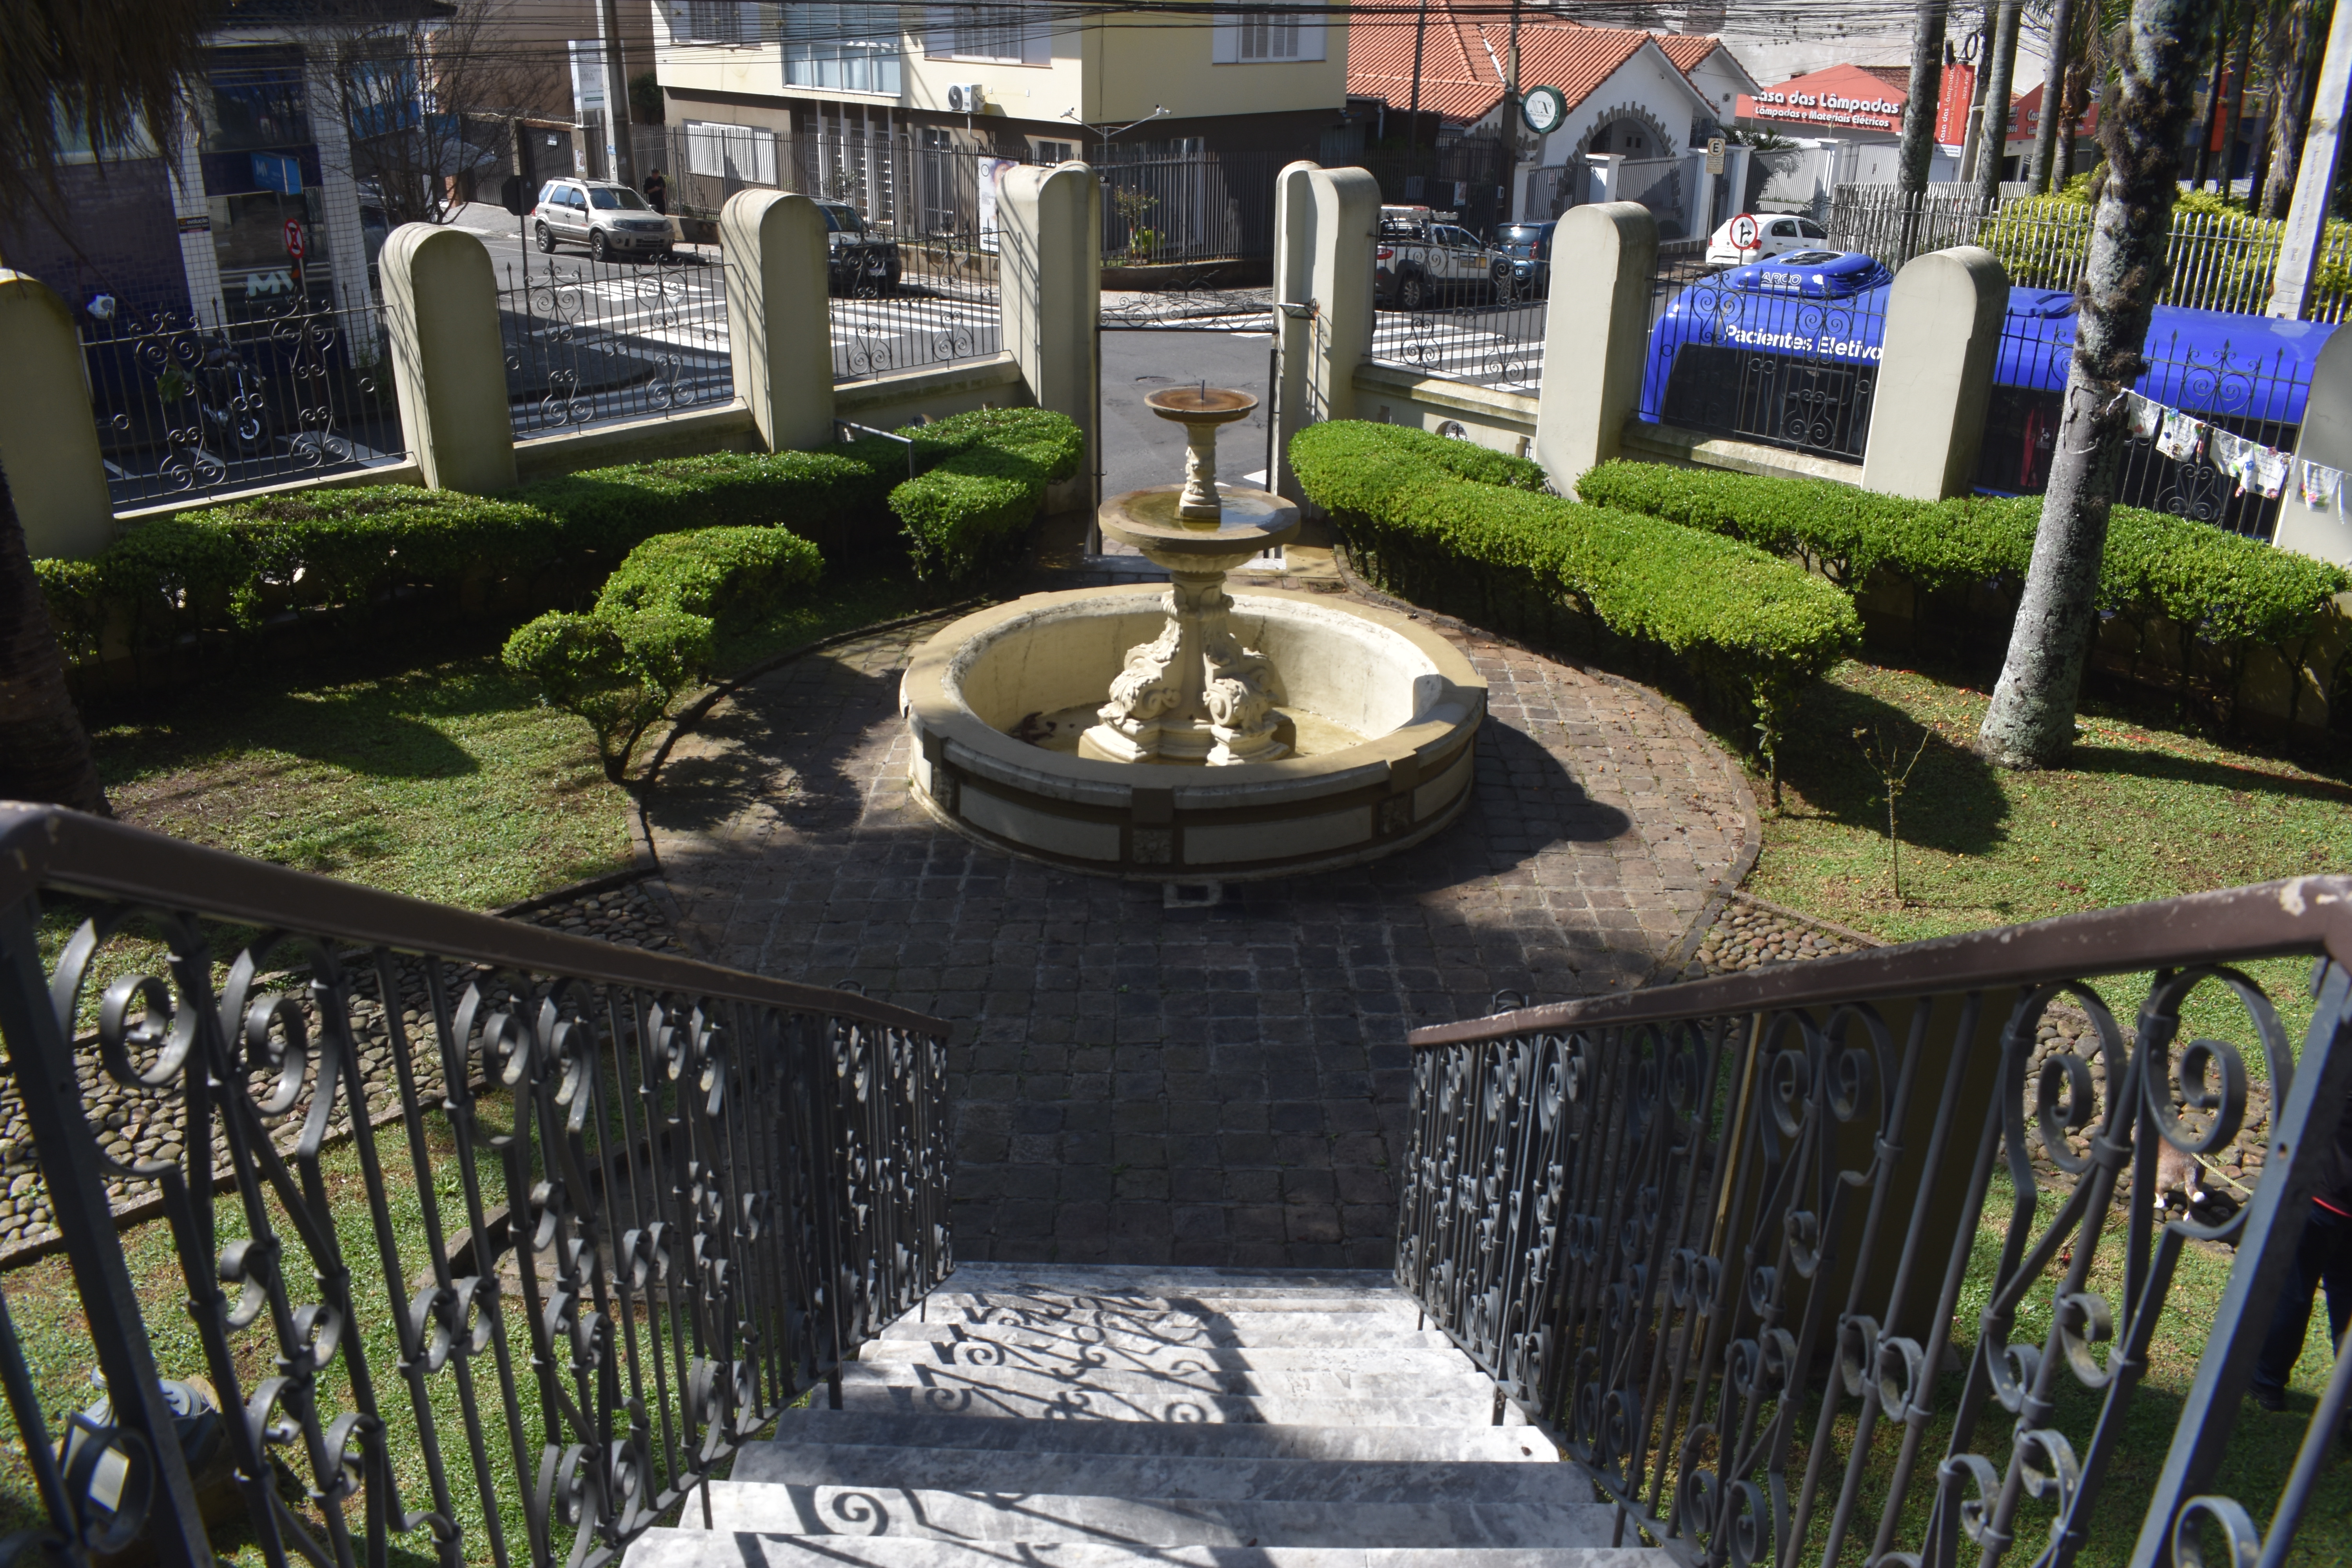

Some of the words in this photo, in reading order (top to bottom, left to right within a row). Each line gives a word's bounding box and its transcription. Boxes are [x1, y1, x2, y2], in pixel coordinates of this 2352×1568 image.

[1789, 90, 1816, 106] das
[1819, 93, 1899, 114] Lâmpadas
[1755, 106, 1800, 118] Lâmpadas
[1808, 110, 1851, 123] Materiais
[1852, 114, 1889, 127] Elétricos
[1938, 124, 1947, 142] Casa
[1713, 143, 1719, 152] E
[1761, 272, 1802, 286] ARCO
[1724, 325, 1813, 352] Pacientes
[1817, 336, 1882, 360] Eletivo
